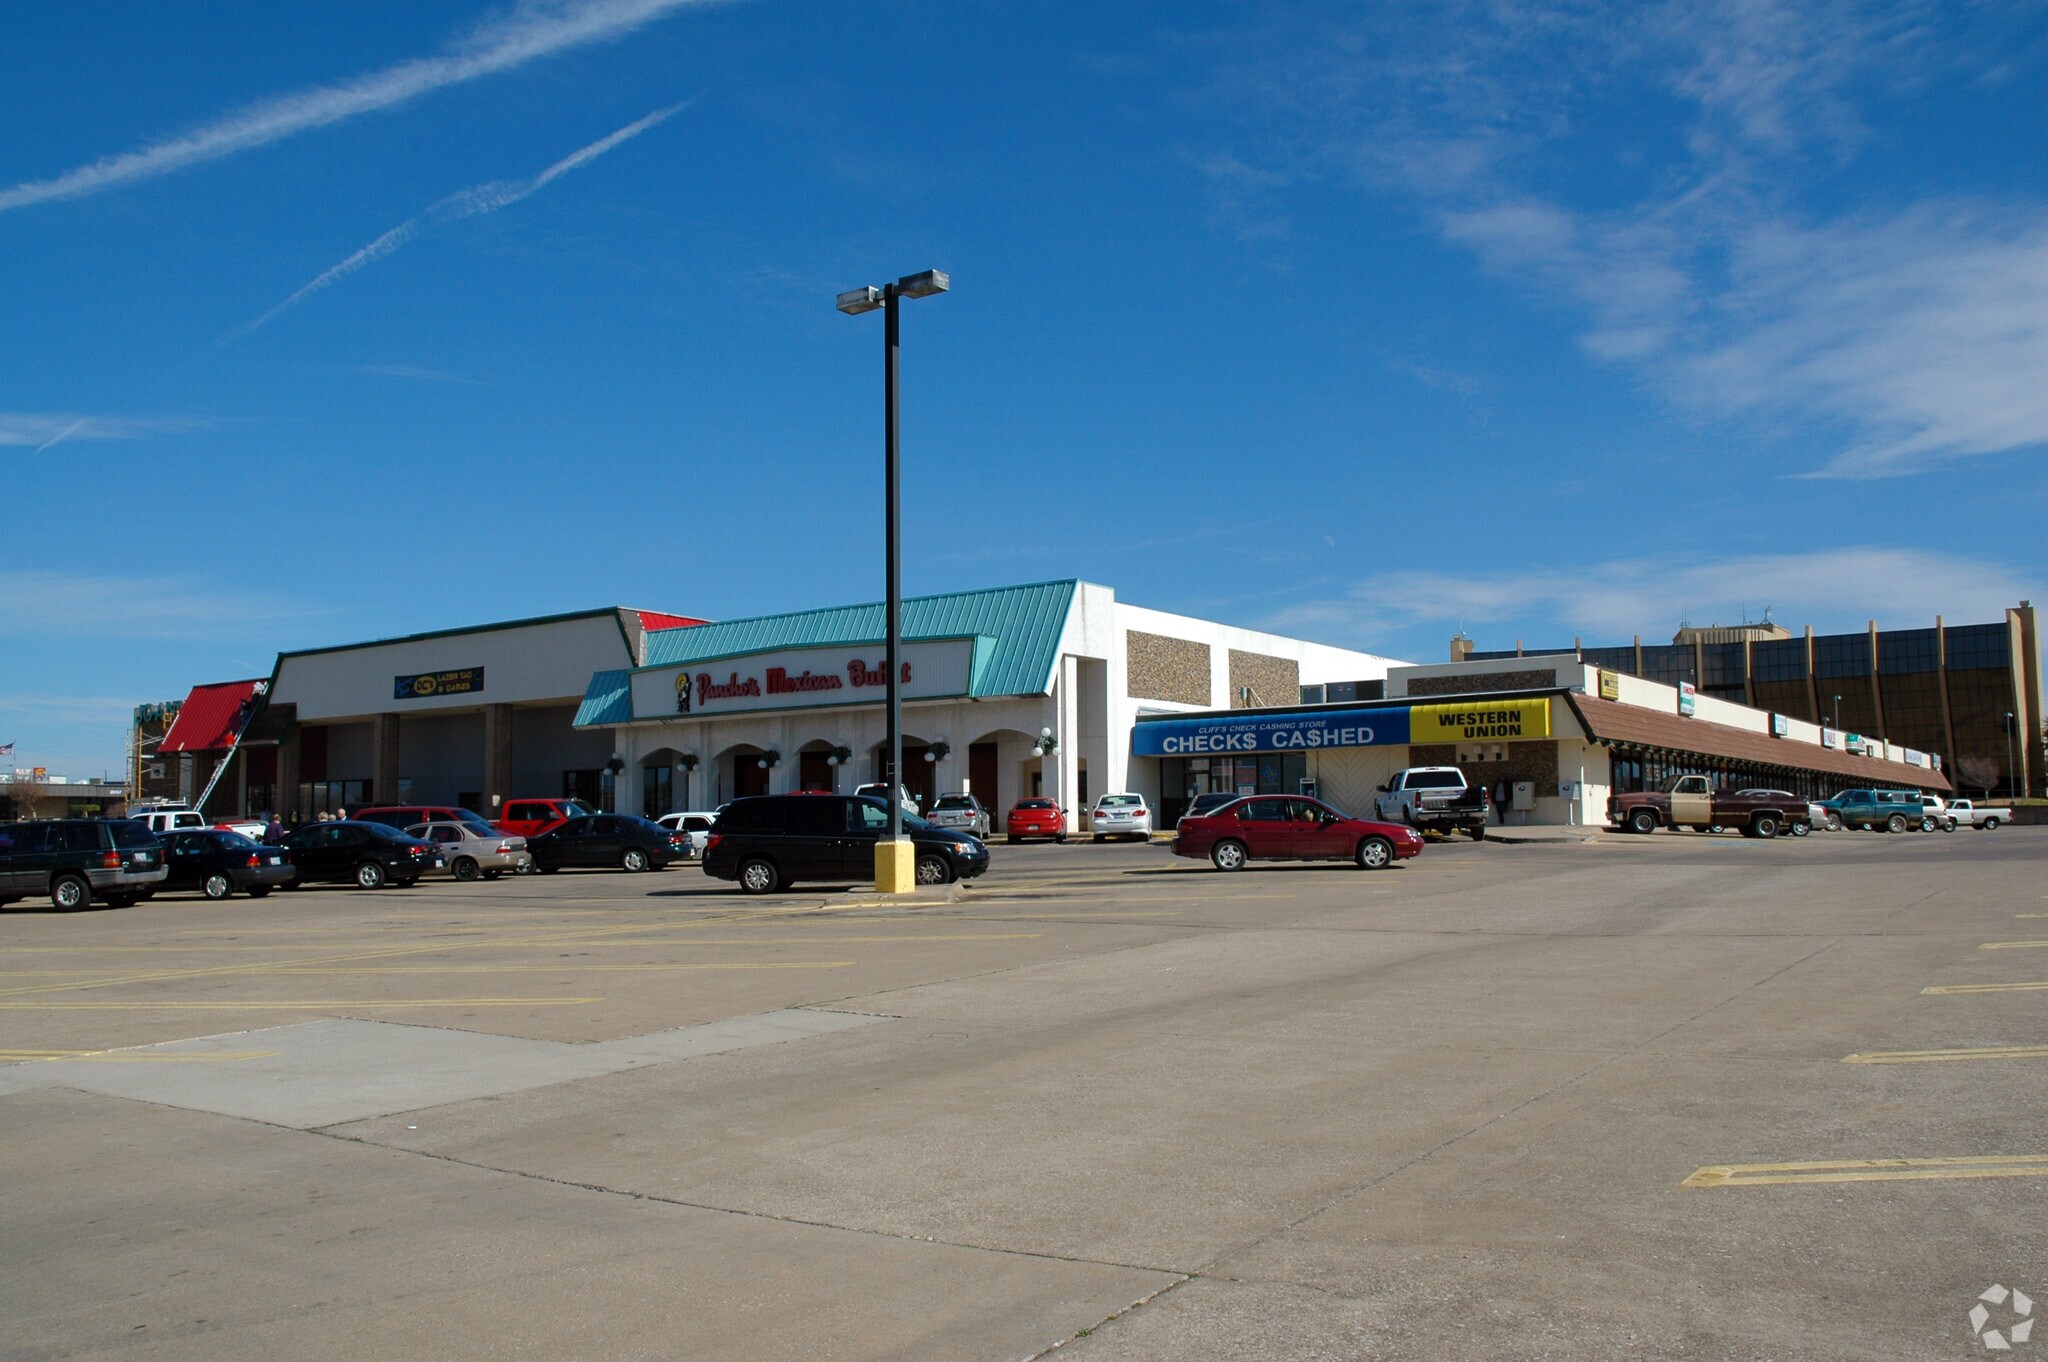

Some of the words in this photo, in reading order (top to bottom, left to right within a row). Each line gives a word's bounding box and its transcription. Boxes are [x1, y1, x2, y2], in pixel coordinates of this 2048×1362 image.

[696, 673, 760, 705] Pancho's
[766, 667, 842, 694] Mexican
[1438, 710, 1521, 726] WESTERN
[1198, 726, 1227, 734] CLIFF'S
[1229, 724, 1257, 732] CHECK
[1259, 722, 1296, 731] CASHING
[1298, 720, 1327, 729] STORE
[1464, 724, 1521, 738] UNION
[1271, 727, 1375, 748] CA$HED
